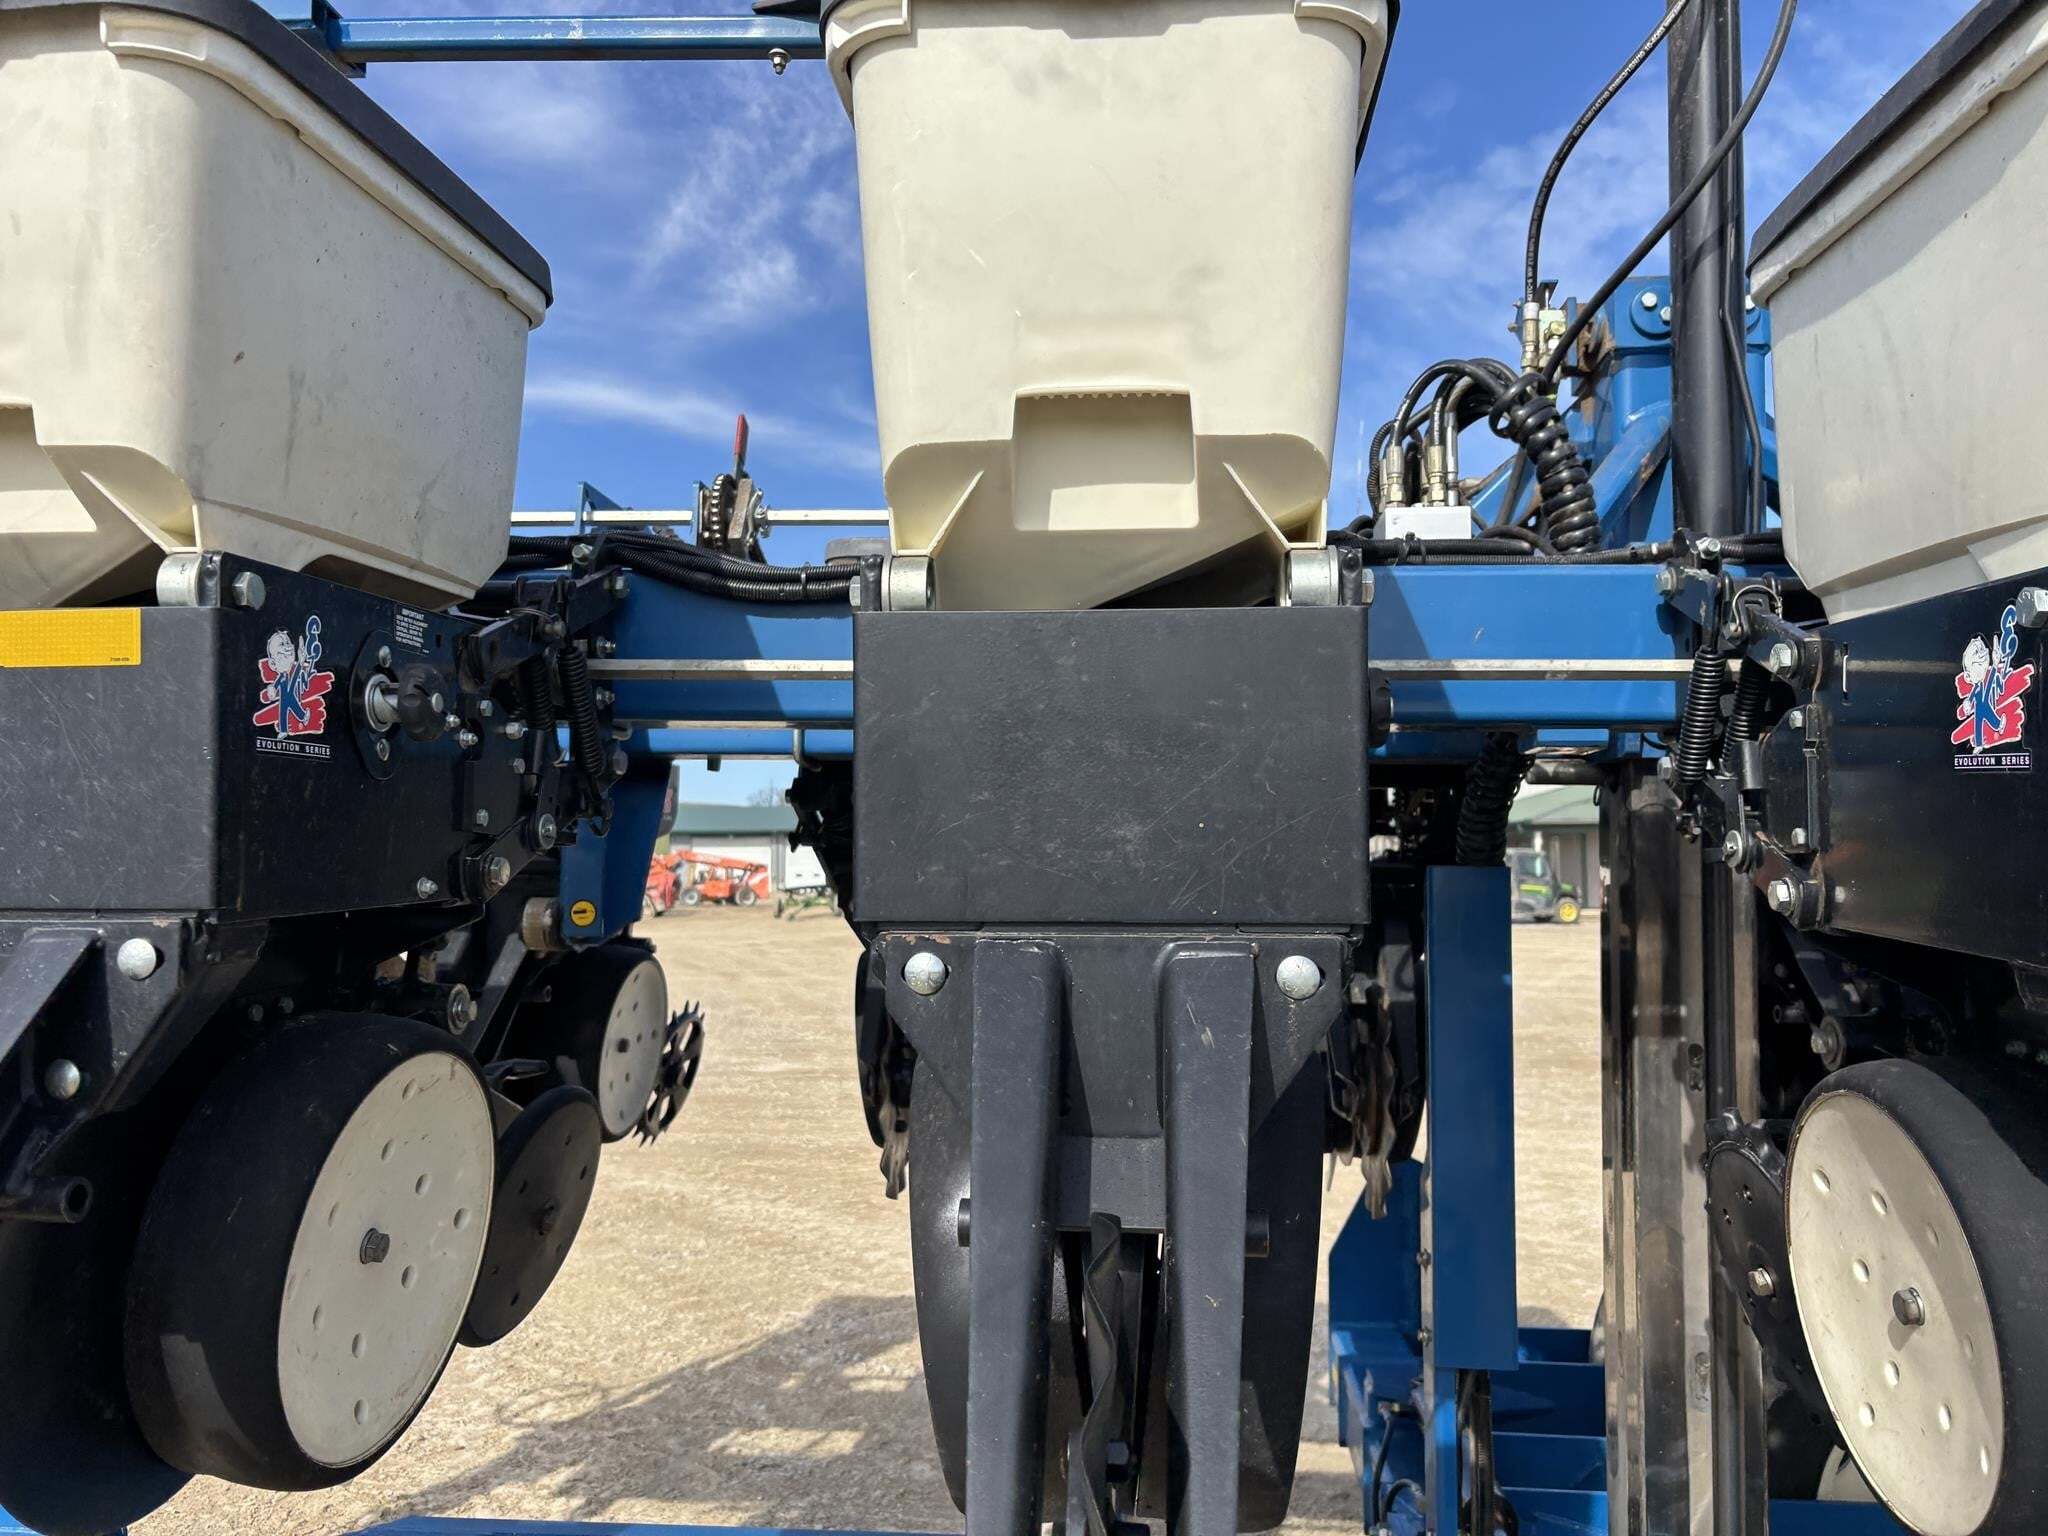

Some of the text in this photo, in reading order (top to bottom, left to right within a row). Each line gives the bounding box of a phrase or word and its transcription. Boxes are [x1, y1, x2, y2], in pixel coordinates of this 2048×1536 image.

[256, 739, 331, 756] EVOLUTION SERIES
[1954, 755, 2030, 766] EVOLUTION SERIES
